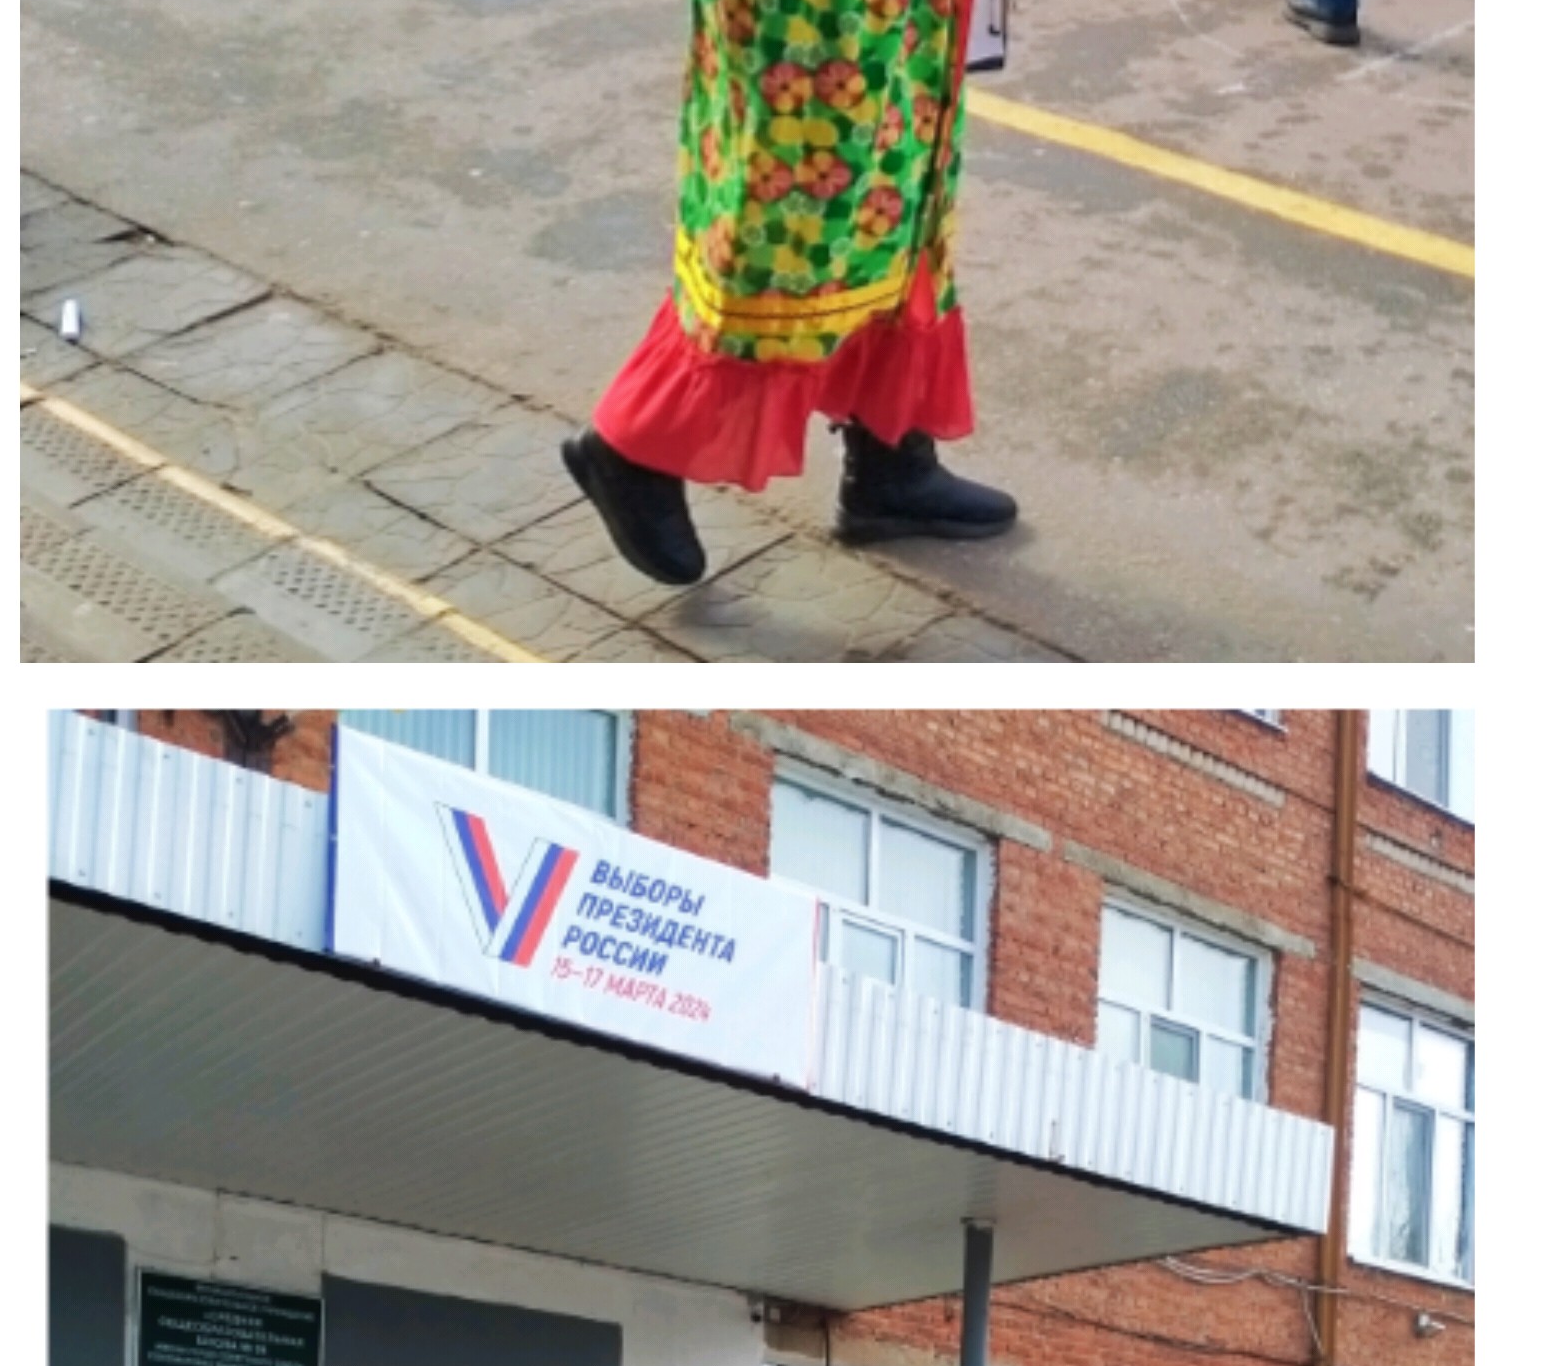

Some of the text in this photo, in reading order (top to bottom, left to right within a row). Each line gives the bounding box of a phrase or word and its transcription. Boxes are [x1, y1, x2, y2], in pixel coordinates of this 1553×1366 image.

[590, 858, 705, 917] ВЫБОРЫ
[561, 925, 669, 977] РОССИИ
[576, 892, 738, 962] ПРЕЗИДЕНТА
[604, 973, 667, 1011] МАРТА
[667, 991, 712, 1022] 2024
